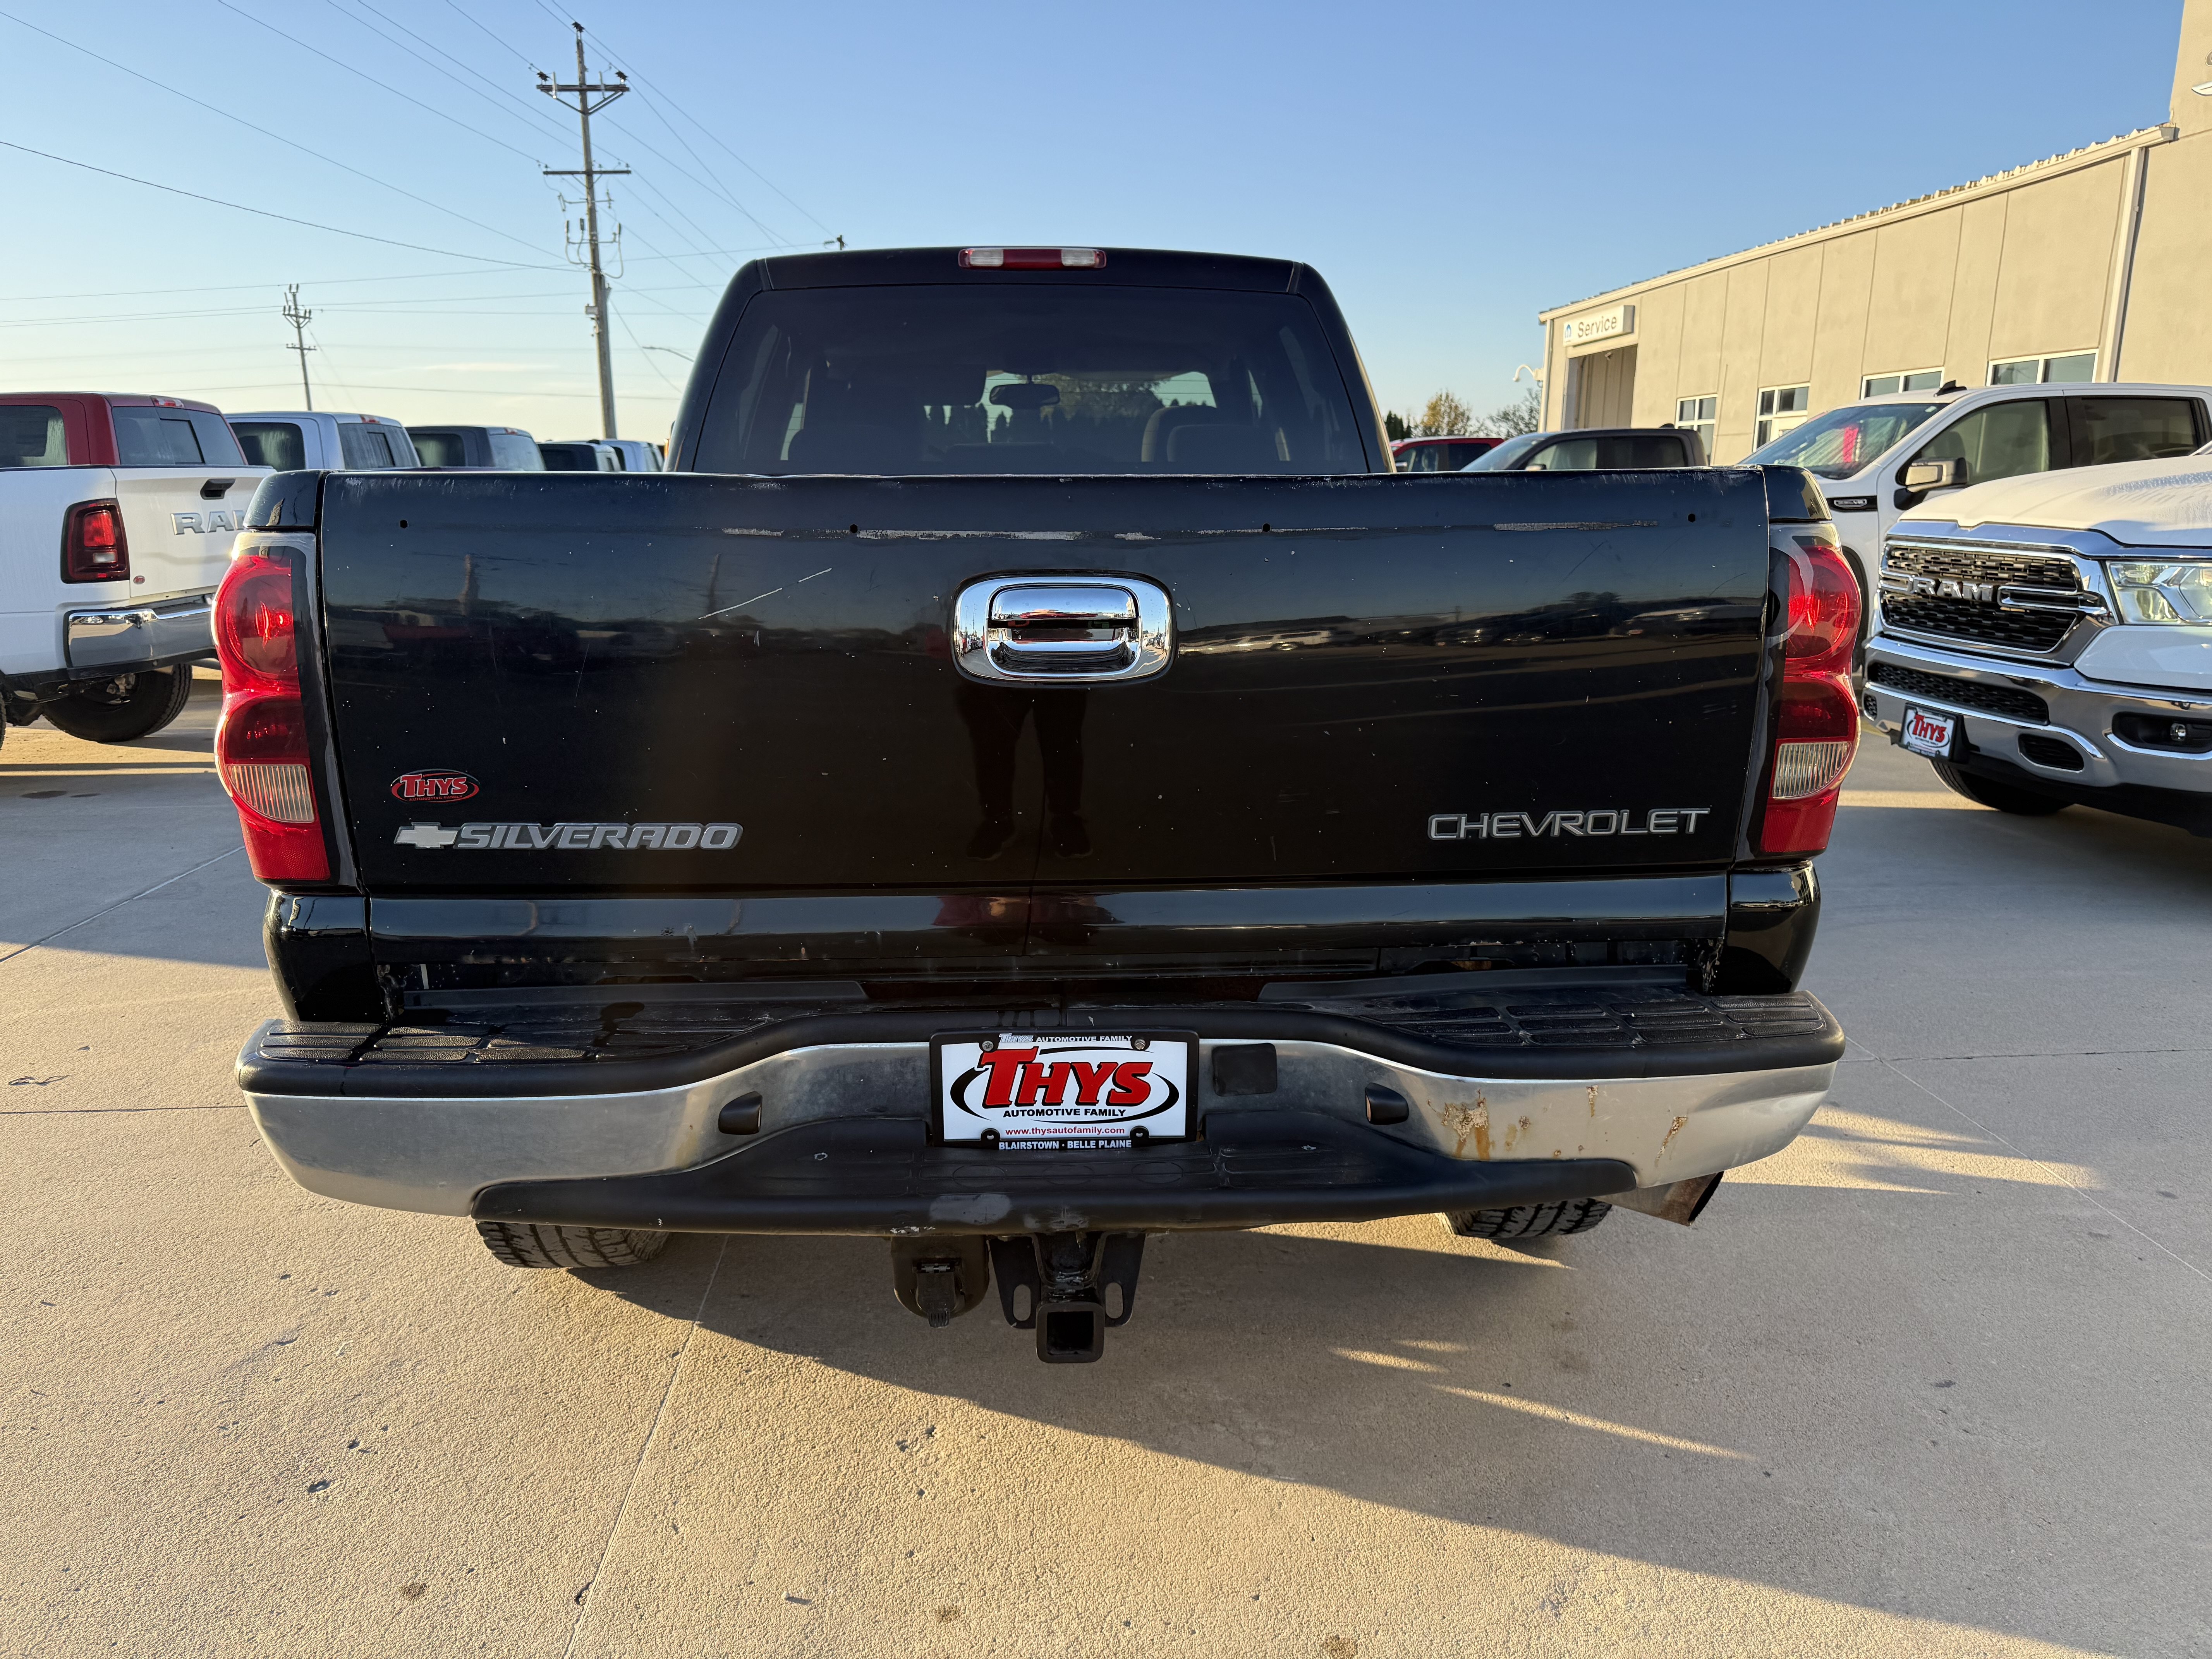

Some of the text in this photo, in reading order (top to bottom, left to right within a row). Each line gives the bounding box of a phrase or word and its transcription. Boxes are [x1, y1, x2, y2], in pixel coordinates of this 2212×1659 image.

[1577, 316, 1617, 338] Service
[1913, 576, 1994, 601] RAM
[1912, 714, 1947, 743] THYS
[400, 774, 468, 797] THYS
[1430, 809, 1710, 839] CHEVROLET
[457, 824, 740, 848] SILVERADO
[978, 1046, 1154, 1108] THYS
[1003, 1108, 1080, 1118] AUTOMOTIVE
[1006, 1126, 1125, 1136] www.thysautofamily.com
[999, 1140, 1132, 1150] BLAIRSTOWN BELLE PLAINE
